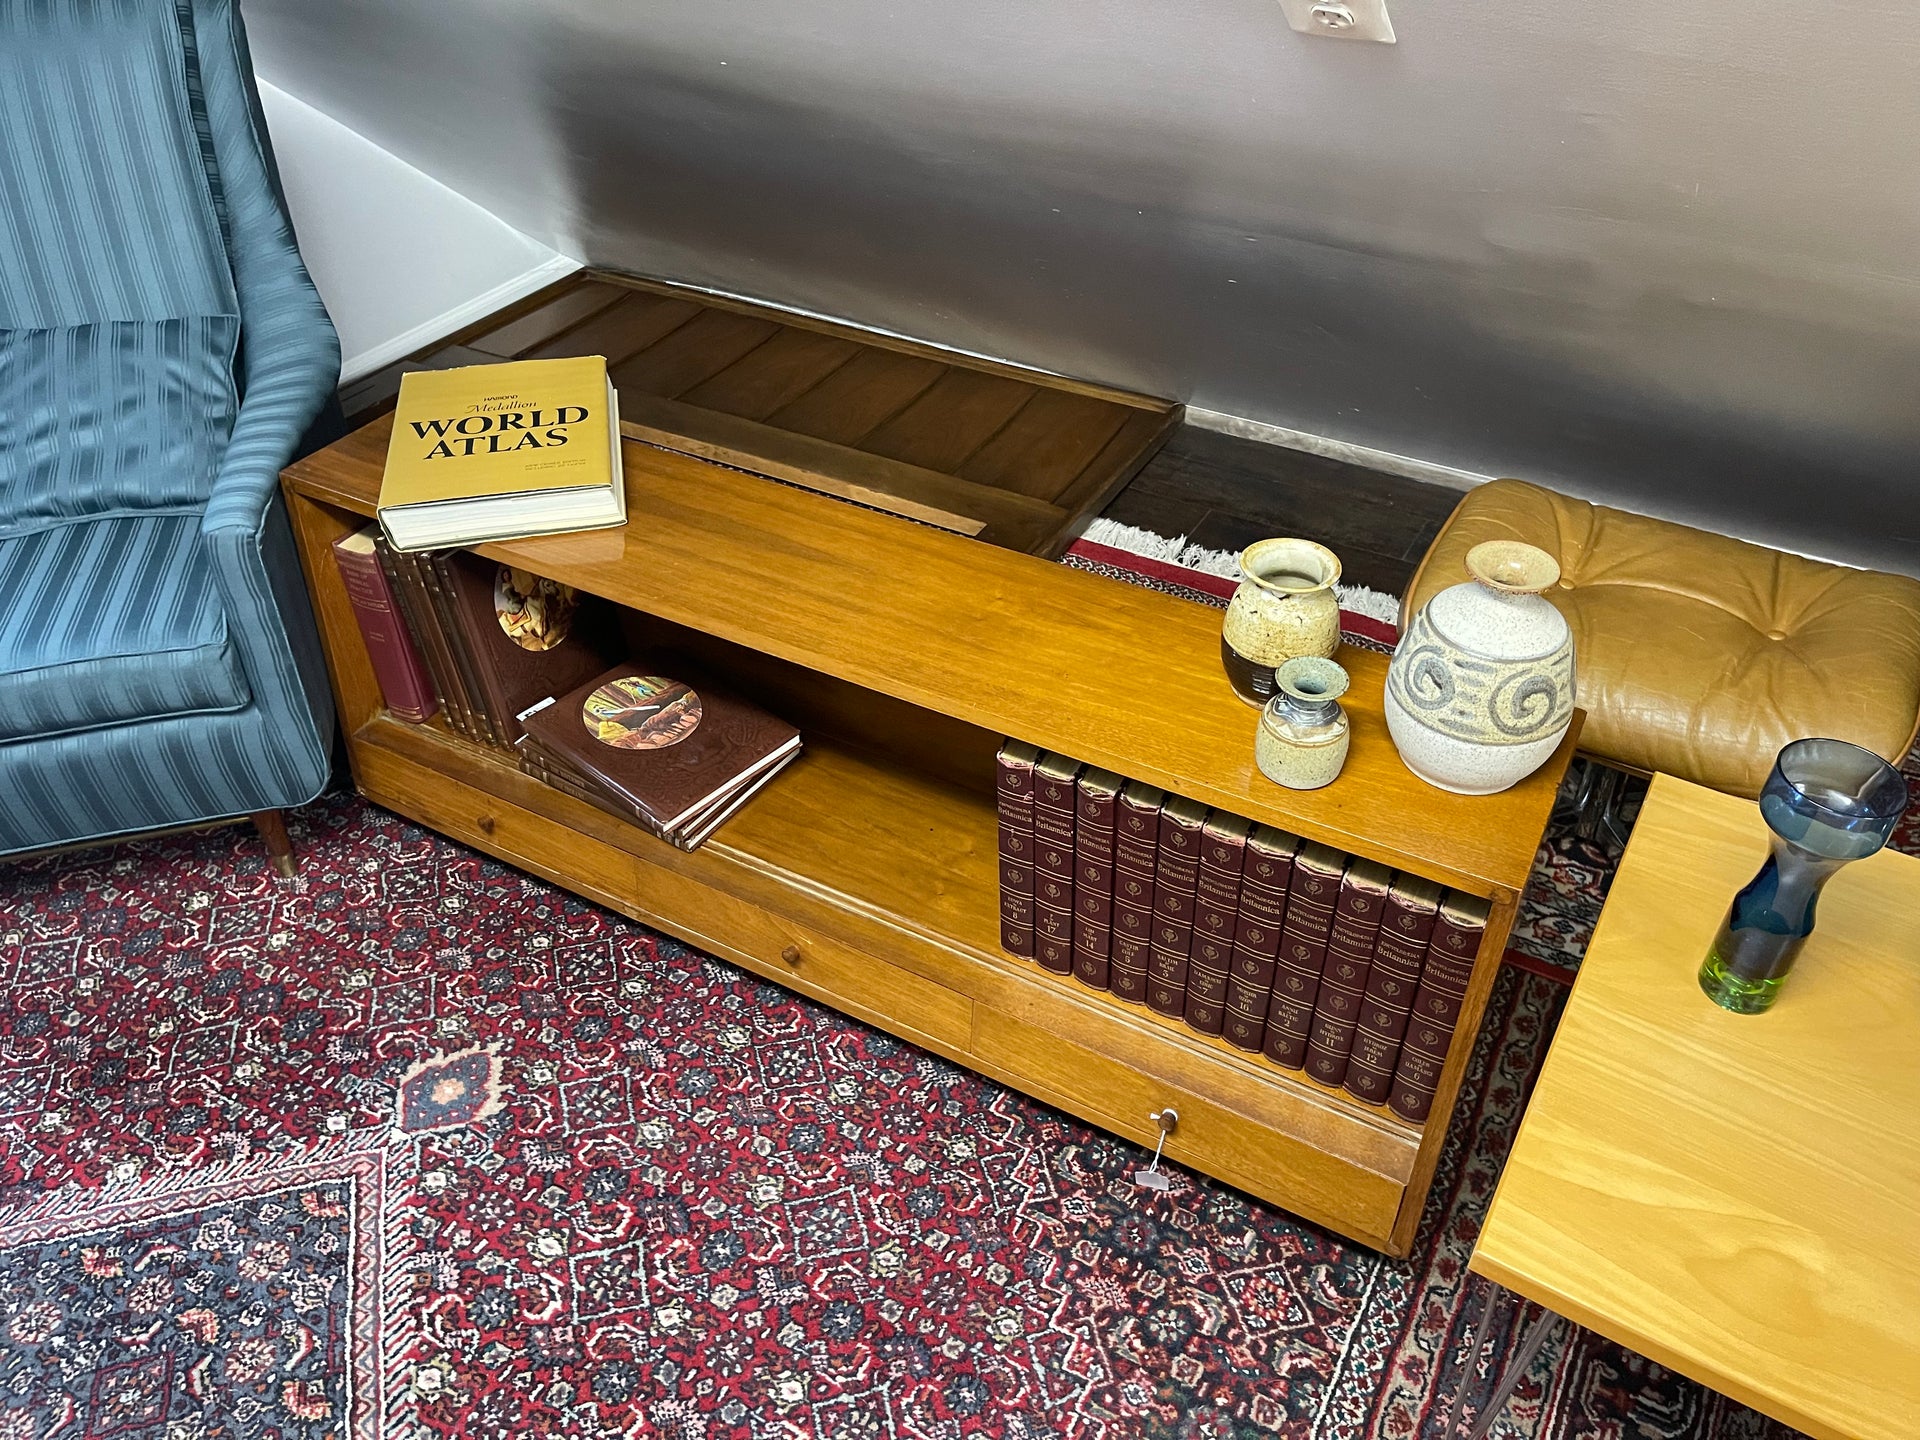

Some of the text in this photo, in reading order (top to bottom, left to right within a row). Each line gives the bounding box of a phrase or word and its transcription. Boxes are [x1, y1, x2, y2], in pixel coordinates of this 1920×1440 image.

[465, 401, 537, 414] Medallion
[409, 406, 589, 439] WORLD
[423, 428, 569, 460] ATLAS
[1036, 820, 1071, 837] Britannica
[1158, 863, 1195, 882] Britannica
[1199, 880, 1237, 899] Britannica
[1240, 894, 1280, 915] Britannica
[1287, 911, 1327, 932] Britannica
[1331, 930, 1373, 950] Britannica
[1377, 946, 1420, 967] Britannica
[1425, 964, 1468, 985] Britannica
